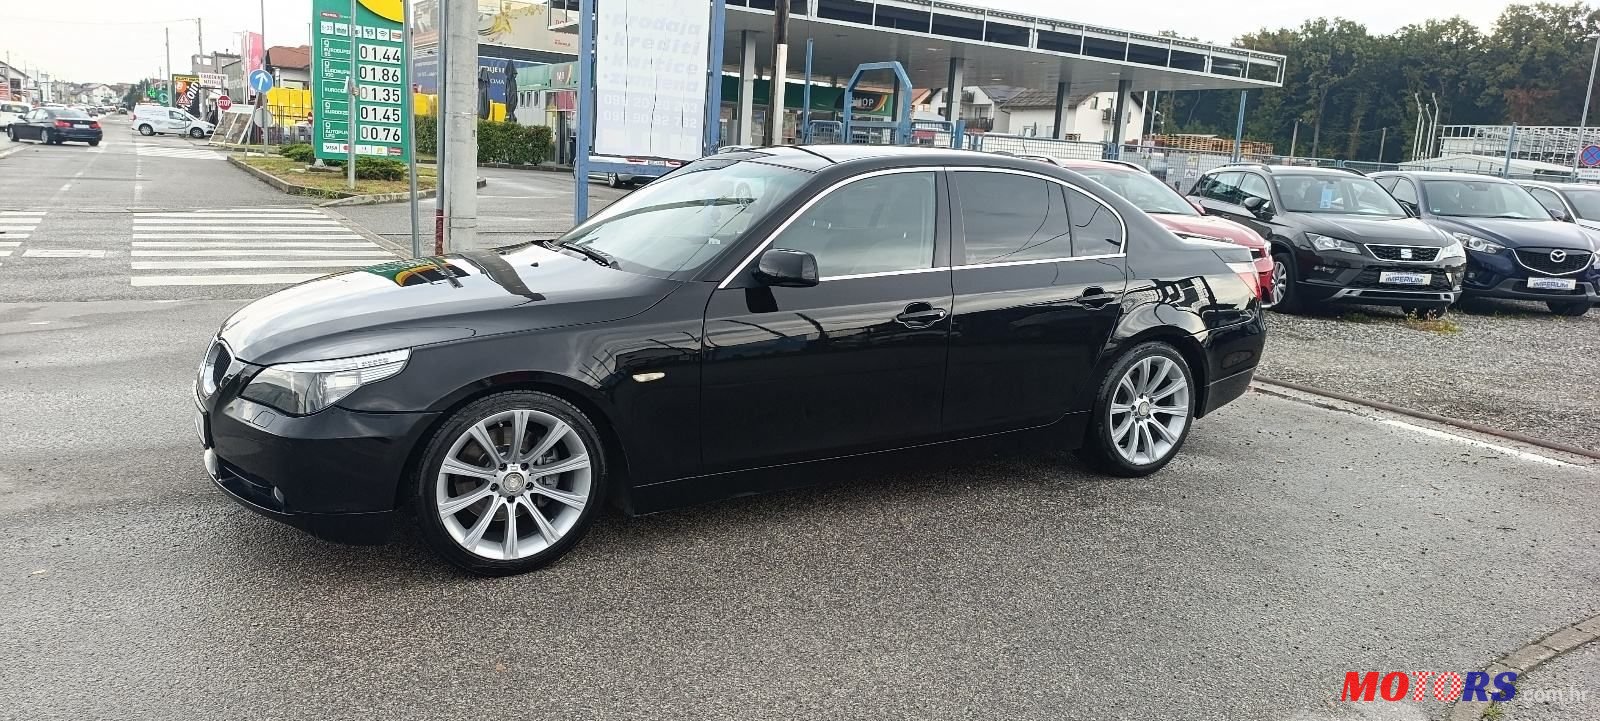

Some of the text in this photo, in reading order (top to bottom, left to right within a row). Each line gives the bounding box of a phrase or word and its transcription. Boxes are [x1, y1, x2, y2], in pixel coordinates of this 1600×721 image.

[361, 46, 400, 62] 01.44
[360, 66, 399, 82] 01.86
[361, 87, 400, 102] 01.35
[361, 107, 400, 122] 01.45
[362, 126, 400, 142] 00.76
